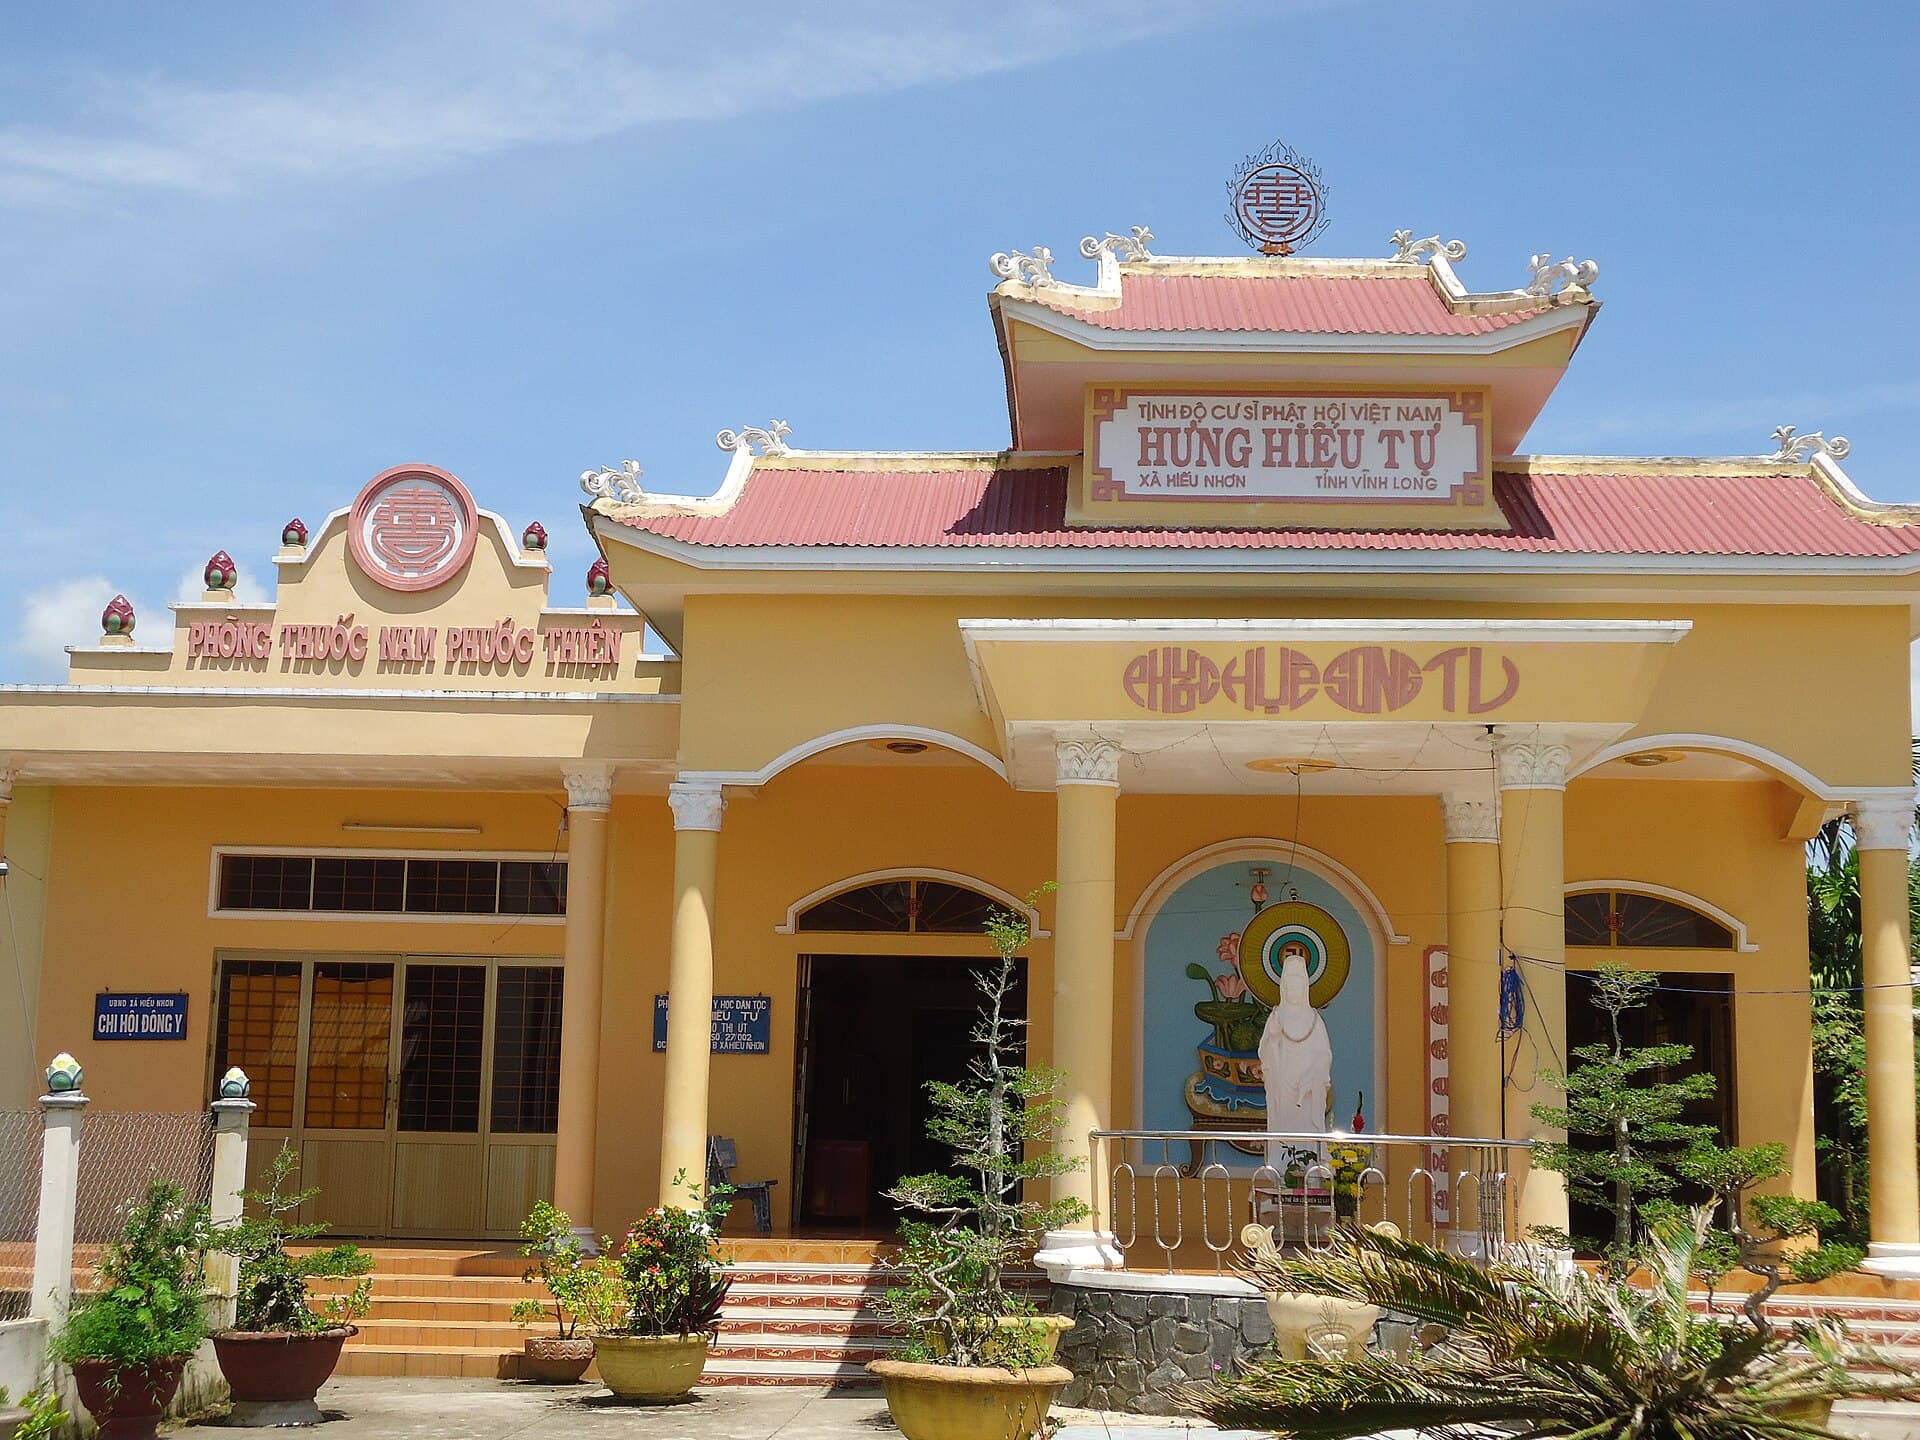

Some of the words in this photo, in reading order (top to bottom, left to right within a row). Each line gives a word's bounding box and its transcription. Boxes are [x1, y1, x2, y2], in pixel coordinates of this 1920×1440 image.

[1138, 402, 1177, 421] TỊNH
[1180, 402, 1207, 422] ĐỘ
[1211, 402, 1241, 420] CƯ
[1243, 400, 1259, 420] SĨ
[1262, 403, 1306, 423] PHẬT
[1313, 403, 1346, 424] HỘI
[1350, 403, 1391, 424] VIỆT
[1397, 406, 1442, 421] NAM
[1137, 420, 1252, 468] HƯNG
[1262, 422, 1365, 469] HIẾU
[1377, 422, 1441, 477] TỰ
[1139, 471, 1161, 487] XÃ
[1204, 474, 1246, 488] NHƠN
[1316, 469, 1348, 489] TỈNH
[1352, 469, 1388, 490] VĨNH
[1393, 477, 1438, 491] LONG
[188, 615, 273, 659] PHÒNG
[281, 613, 368, 661] THUỐC
[379, 626, 437, 662] NAM
[447, 616, 535, 664] PHƯỚC
[544, 618, 623, 668] THIỆN
[1323, 646, 1423, 714] SONG
[1423, 646, 1520, 714] TU
[98, 1014, 118, 1033] CHI
[120, 1010, 139, 1036] HỘI
[141, 1010, 173, 1033] ĐÔNG
[175, 1014, 183, 1033] Y
